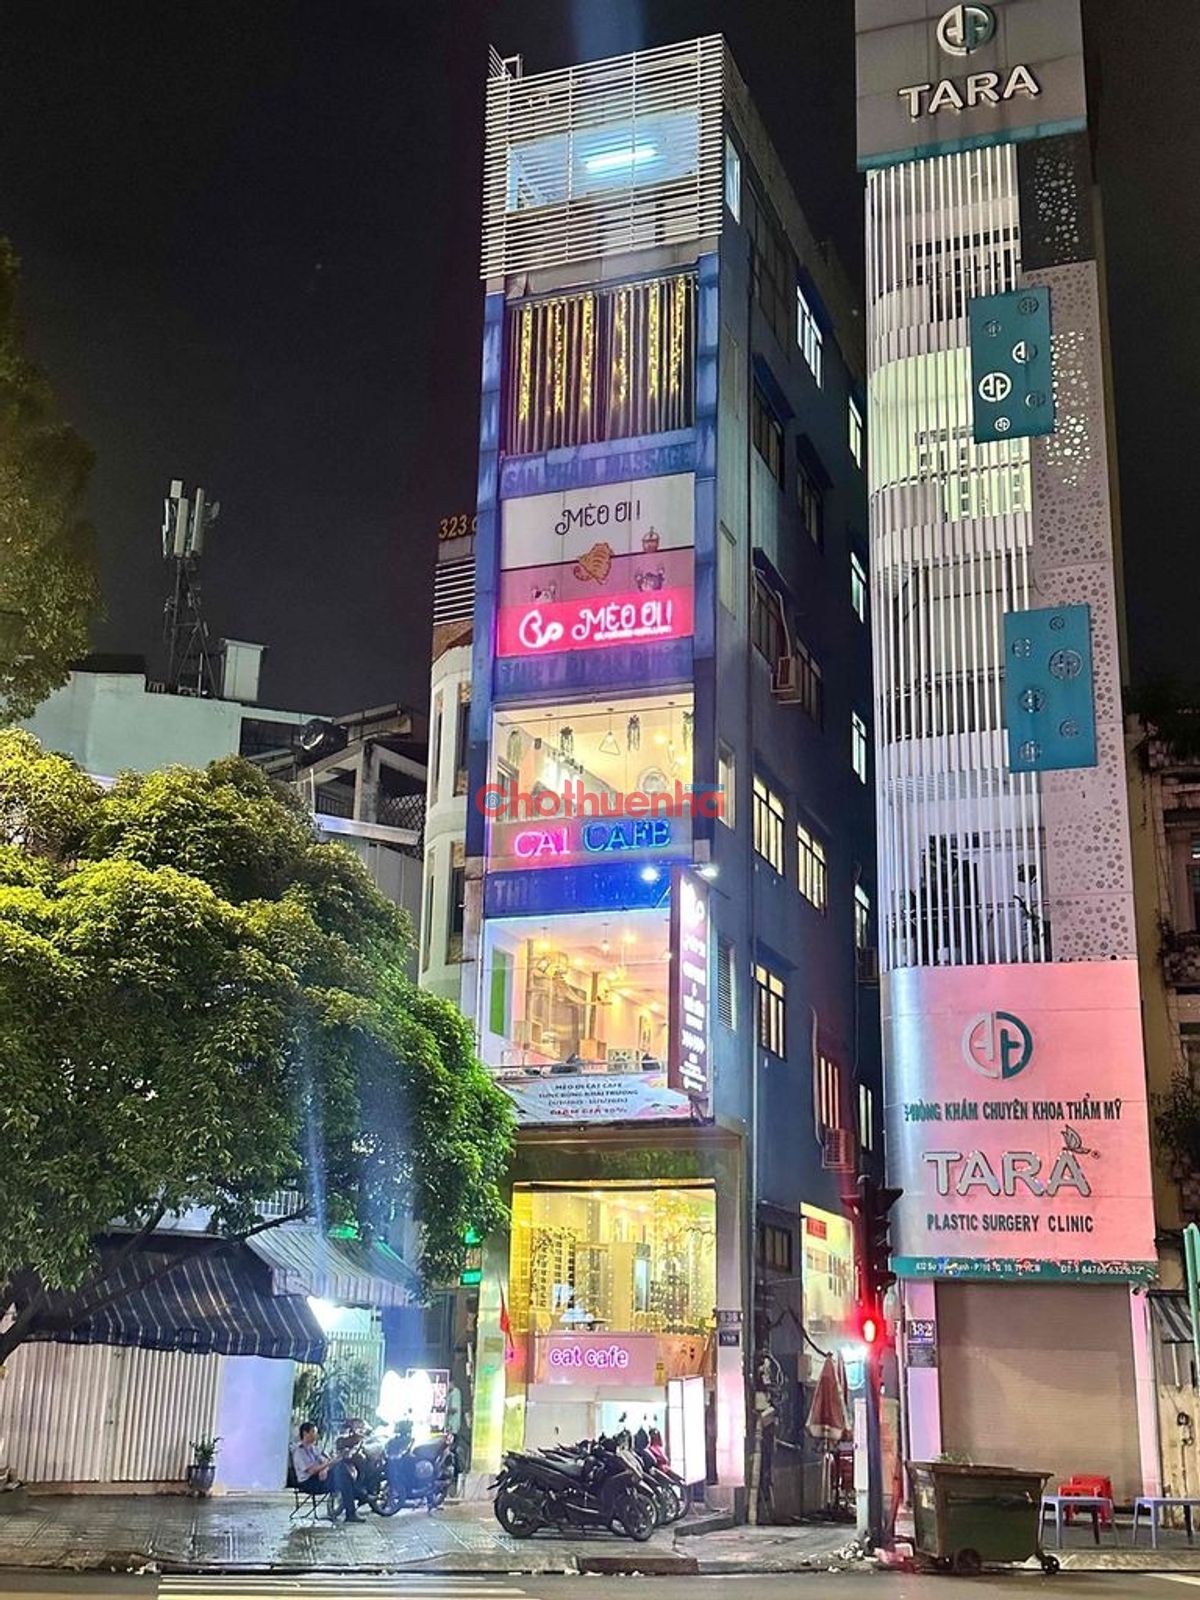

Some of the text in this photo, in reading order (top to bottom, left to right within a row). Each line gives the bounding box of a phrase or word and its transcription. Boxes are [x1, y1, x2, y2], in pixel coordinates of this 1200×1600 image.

[898, 64, 1040, 117] TARA
[438, 514, 468, 539] 323
[582, 819, 671, 851] CAFE
[944, 1098, 978, 1121] KHÁM
[982, 1098, 1029, 1121] CHUYÊN
[1032, 1101, 1064, 1121] KHOA
[1066, 1092, 1101, 1120] THẨM
[1104, 1098, 1122, 1120] MỸ
[922, 1150, 1092, 1197] TARA
[926, 1213, 1094, 1233] PLASTIC SURGERY CLINIC
[550, 1345, 629, 1368] cat cafe
